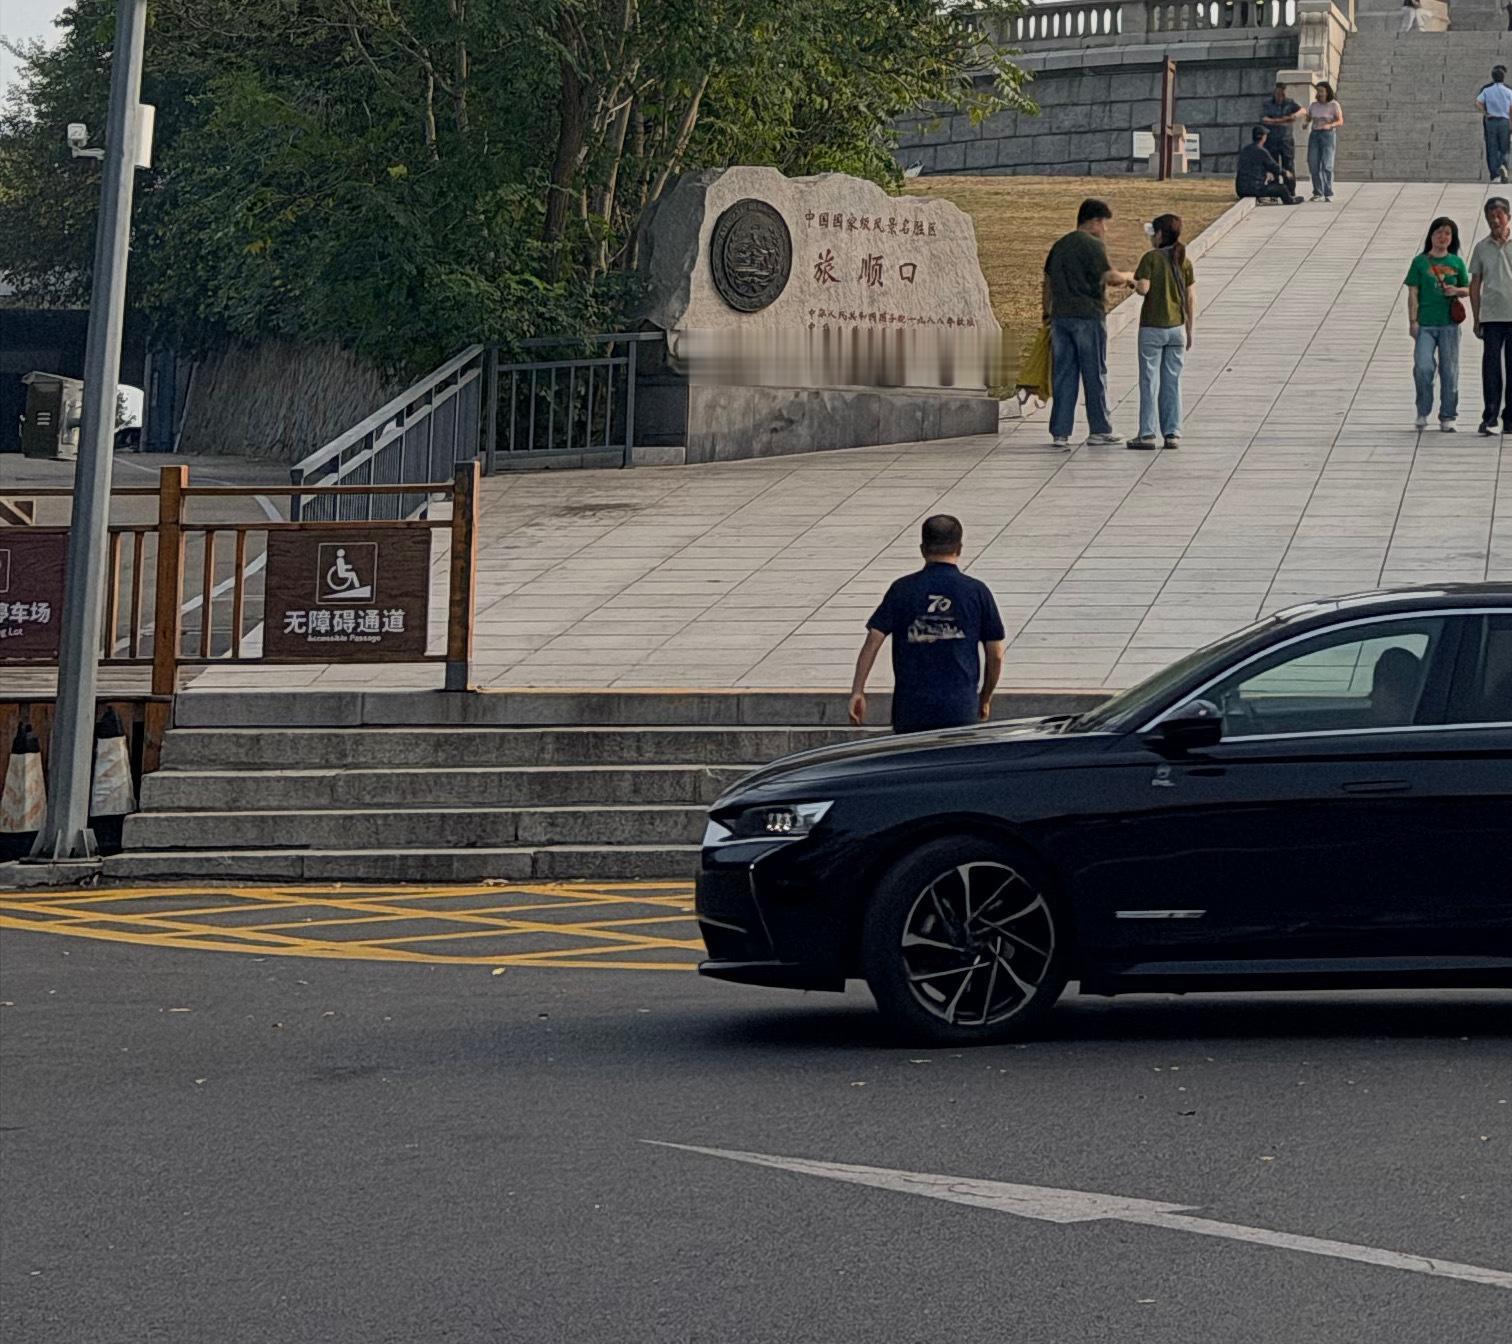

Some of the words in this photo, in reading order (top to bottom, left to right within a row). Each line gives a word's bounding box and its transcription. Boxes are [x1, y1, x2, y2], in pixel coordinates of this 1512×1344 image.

[813, 248, 918, 288] 旅顺口
[926, 594, 952, 613] 70
[283, 608, 406, 635] 无障碍通道
